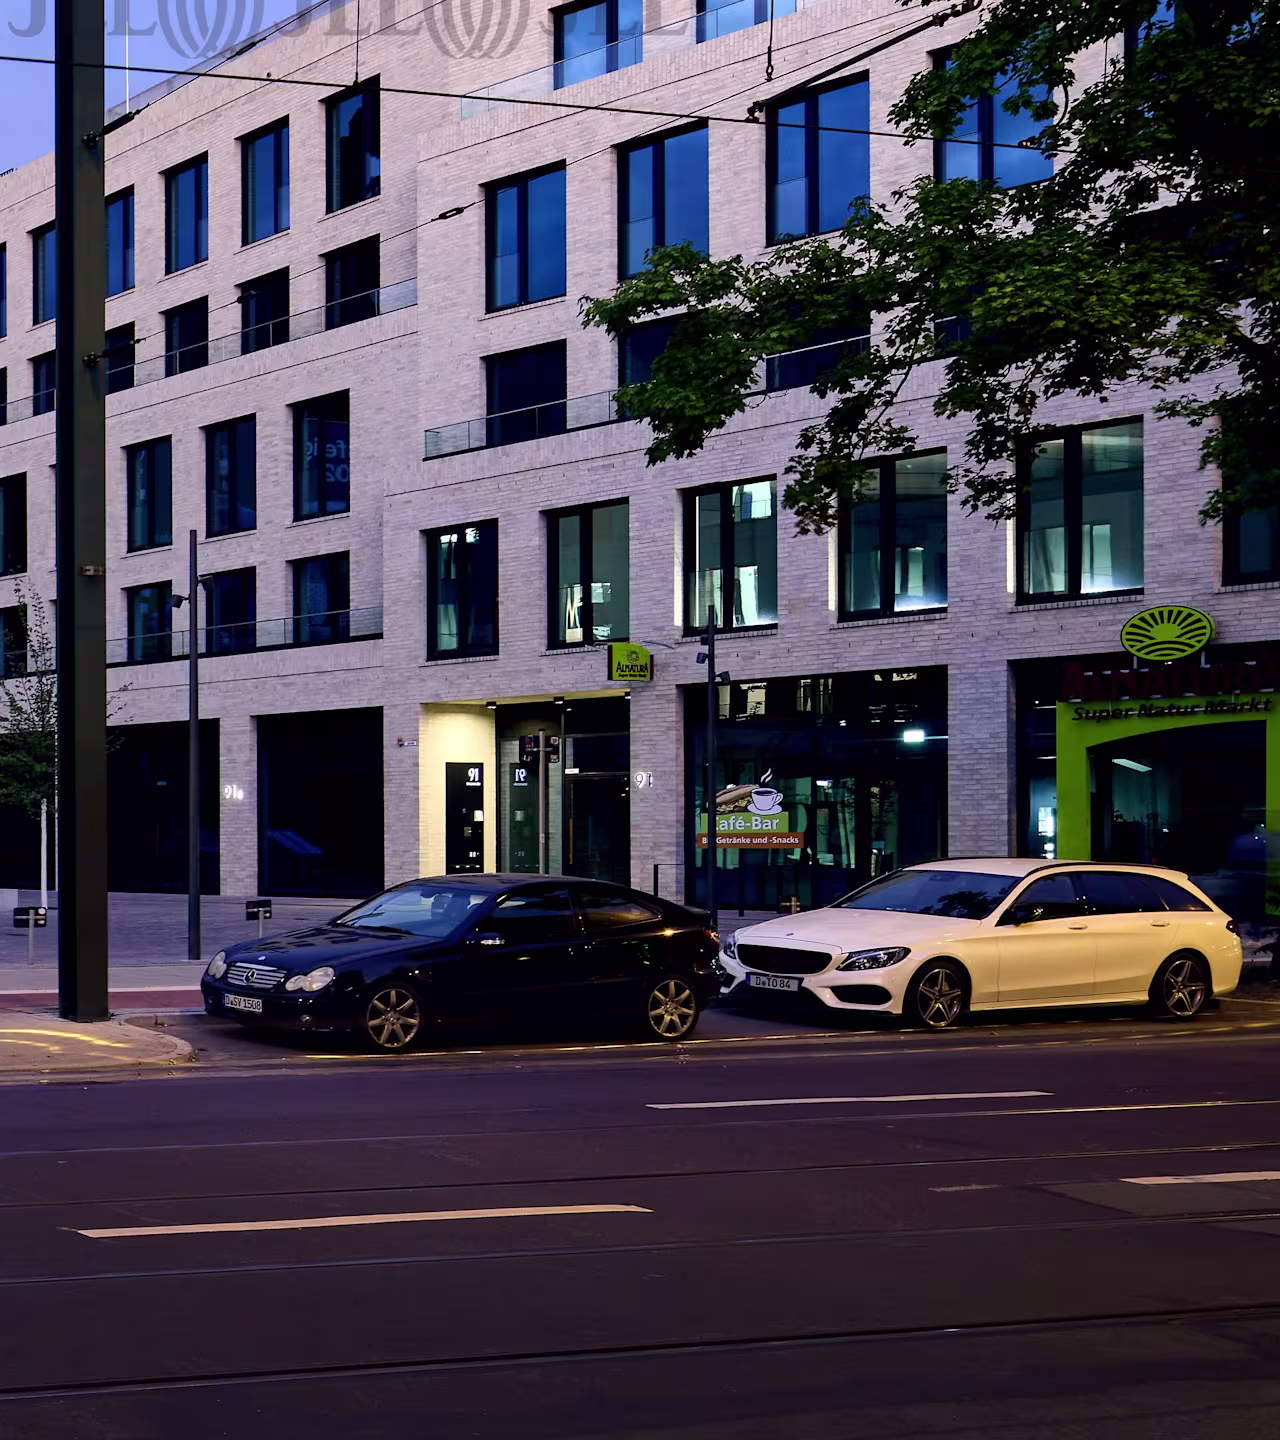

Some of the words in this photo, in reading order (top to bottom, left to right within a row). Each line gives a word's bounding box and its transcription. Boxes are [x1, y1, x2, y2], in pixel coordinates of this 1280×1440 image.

[467, 767, 480, 781] 91
[634, 771, 653, 788] 91
[752, 836, 768, 844] und
[770, 835, 799, 844] -Snacks
